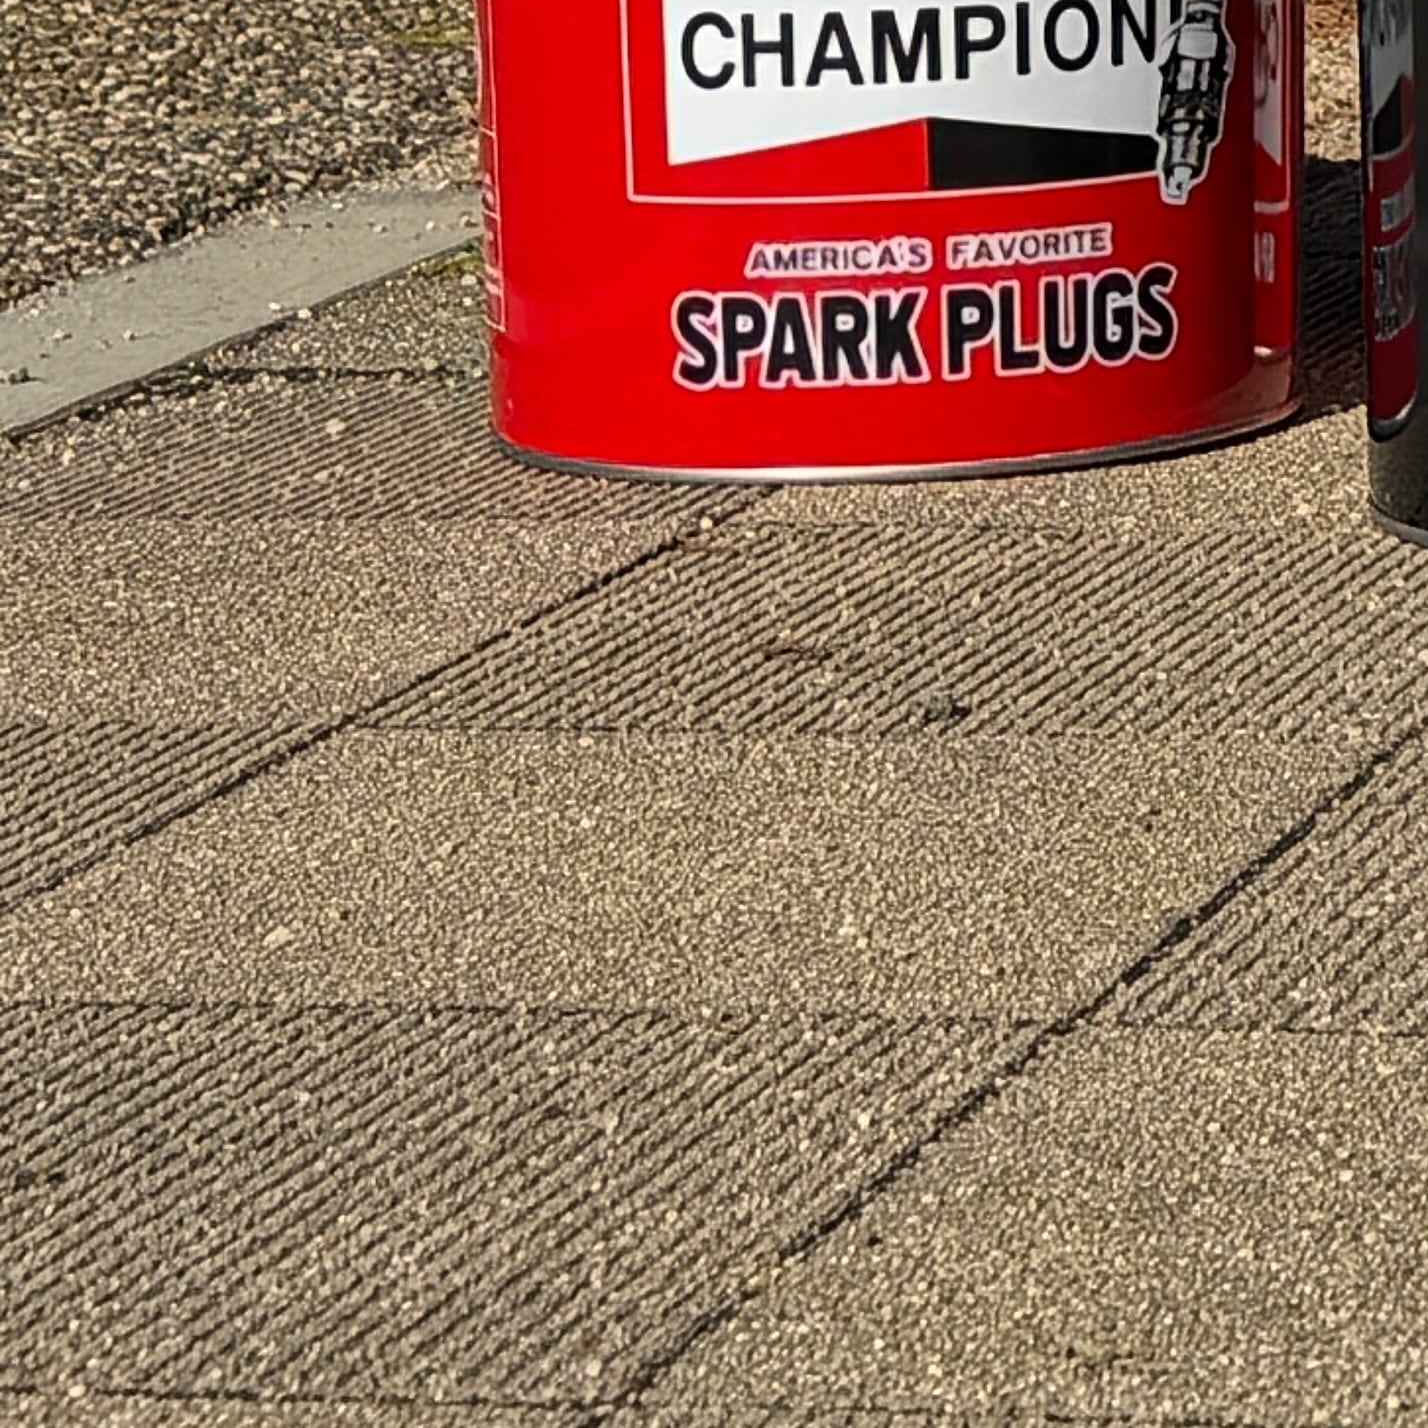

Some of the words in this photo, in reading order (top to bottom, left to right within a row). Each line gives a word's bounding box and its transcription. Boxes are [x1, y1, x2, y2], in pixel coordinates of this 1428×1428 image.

[747, 237, 932, 278] AMERICA'S
[948, 223, 1111, 270] FAVORITE
[672, 286, 930, 392] SPARK
[941, 263, 1179, 381] PLUGS
